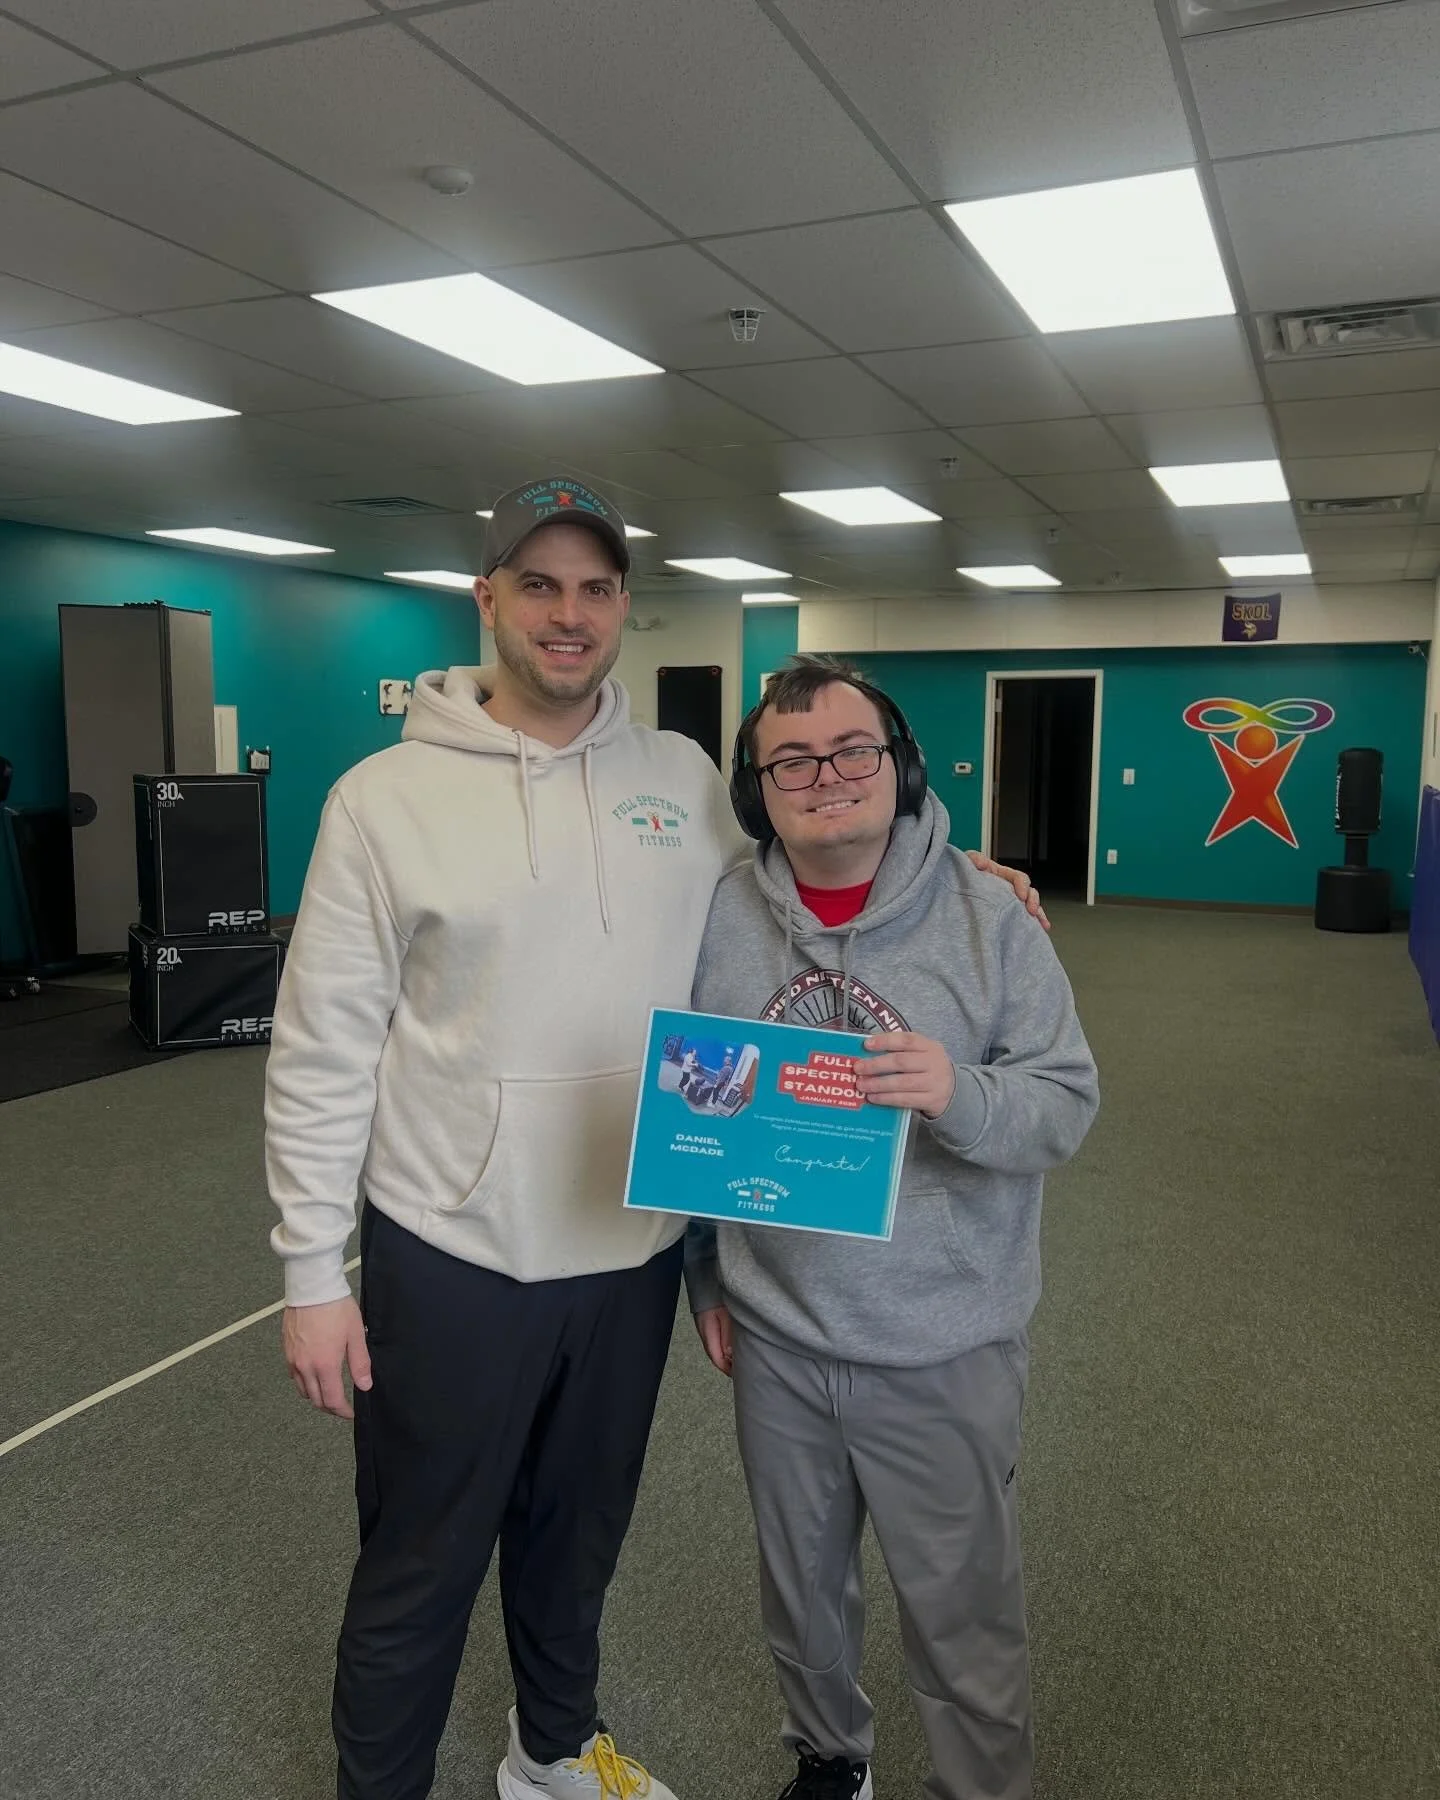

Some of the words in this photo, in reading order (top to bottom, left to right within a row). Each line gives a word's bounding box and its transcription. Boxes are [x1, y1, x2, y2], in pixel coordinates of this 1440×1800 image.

[517, 485, 547, 505] FULL
[550, 480, 608, 516] SPECTRUM
[1232, 603, 1272, 621] SKOL
[156, 782, 179, 801] 30
[157, 800, 176, 809] INCH
[612, 798, 637, 820] FULL
[636, 795, 689, 822] SPECTRUM
[638, 834, 682, 848] FITNESS
[208, 909, 266, 927] REP
[208, 925, 267, 935] FITNESS
[156, 947, 178, 965] 20
[156, 964, 174, 972] INCH
[221, 1032, 271, 1041] FITNES
[814, 1055, 854, 1068] FULL
[784, 1066, 858, 1083] SPECTR
[783, 1081, 866, 1099] STANDOU
[675, 1133, 722, 1146] DANIEL
[670, 1144, 725, 1157] MCDADE
[727, 1178, 748, 1191] FULL
[749, 1177, 791, 1198] SPECTRUM
[737, 1201, 775, 1213] FITNESS
